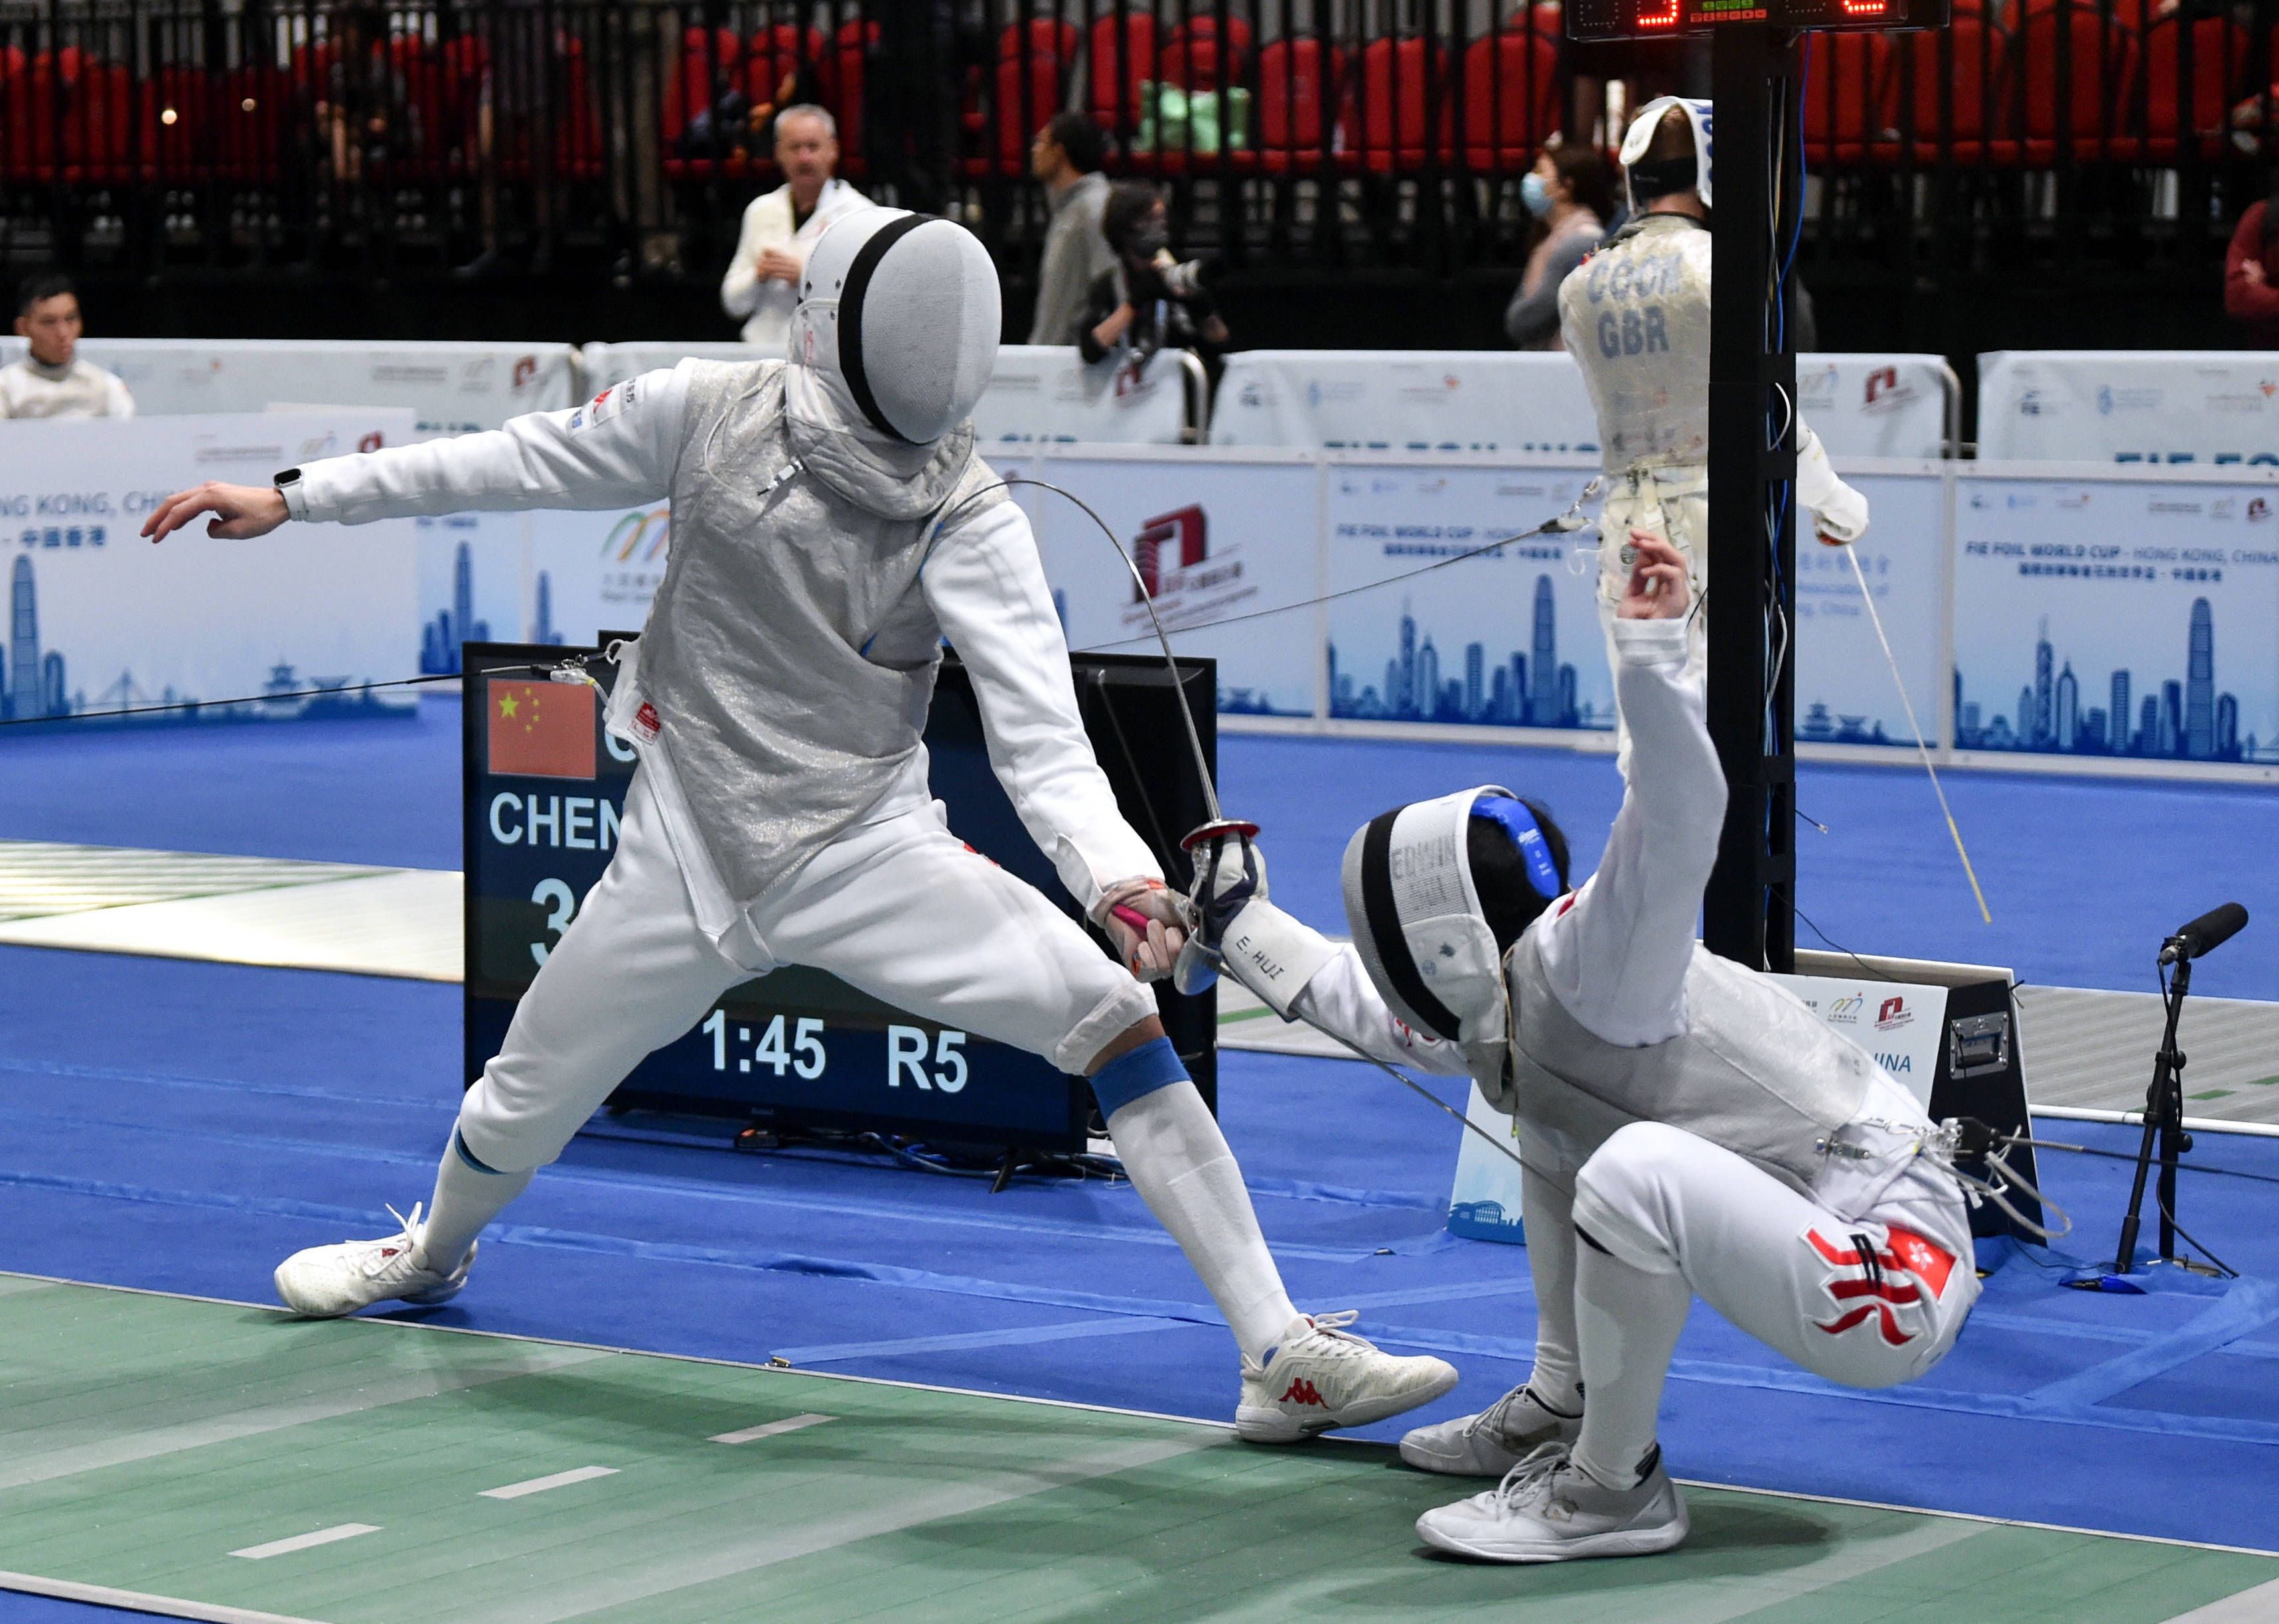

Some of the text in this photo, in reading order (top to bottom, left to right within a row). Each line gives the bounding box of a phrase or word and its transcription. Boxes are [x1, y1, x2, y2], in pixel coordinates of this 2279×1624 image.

[1597, 305, 1669, 359] GBR
[35, 492, 117, 518] KONG,
[1966, 541, 1988, 555] FIE
[1993, 542, 2025, 555] FOIL
[2031, 544, 2085, 557] WORLD
[2091, 545, 2121, 559] CUP
[1236, 936, 1285, 981] E. HUI
[702, 1009, 968, 1093] 1:45 R5
[1874, 1052, 1911, 1072] INA
